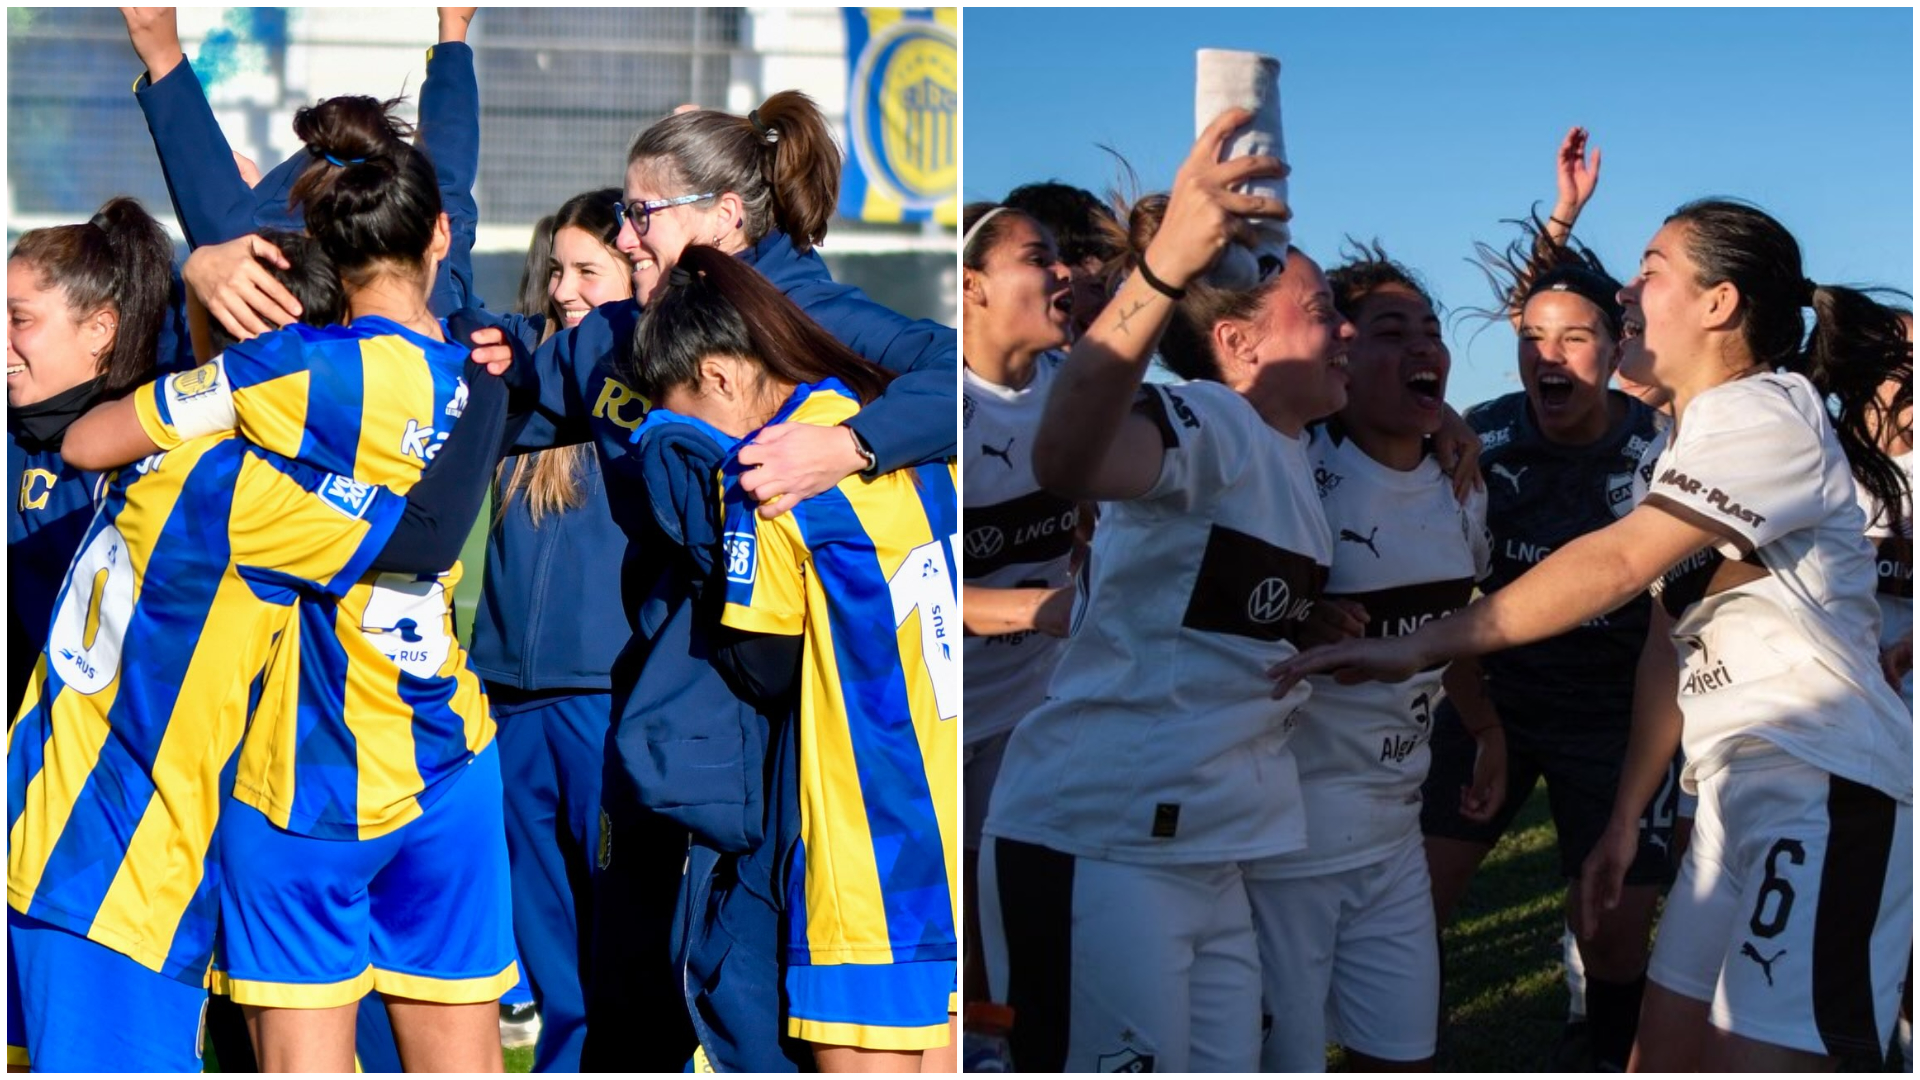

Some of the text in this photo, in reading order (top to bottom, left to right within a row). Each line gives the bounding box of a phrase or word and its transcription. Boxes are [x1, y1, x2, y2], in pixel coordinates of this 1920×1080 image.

[592, 377, 652, 432] RC
[1014, 517, 1056, 546] LNG
[932, 604, 946, 638] RUS
[75, 655, 96, 680] RUS
[400, 650, 428, 662] RUS
[1750, 838, 1805, 938] 6
